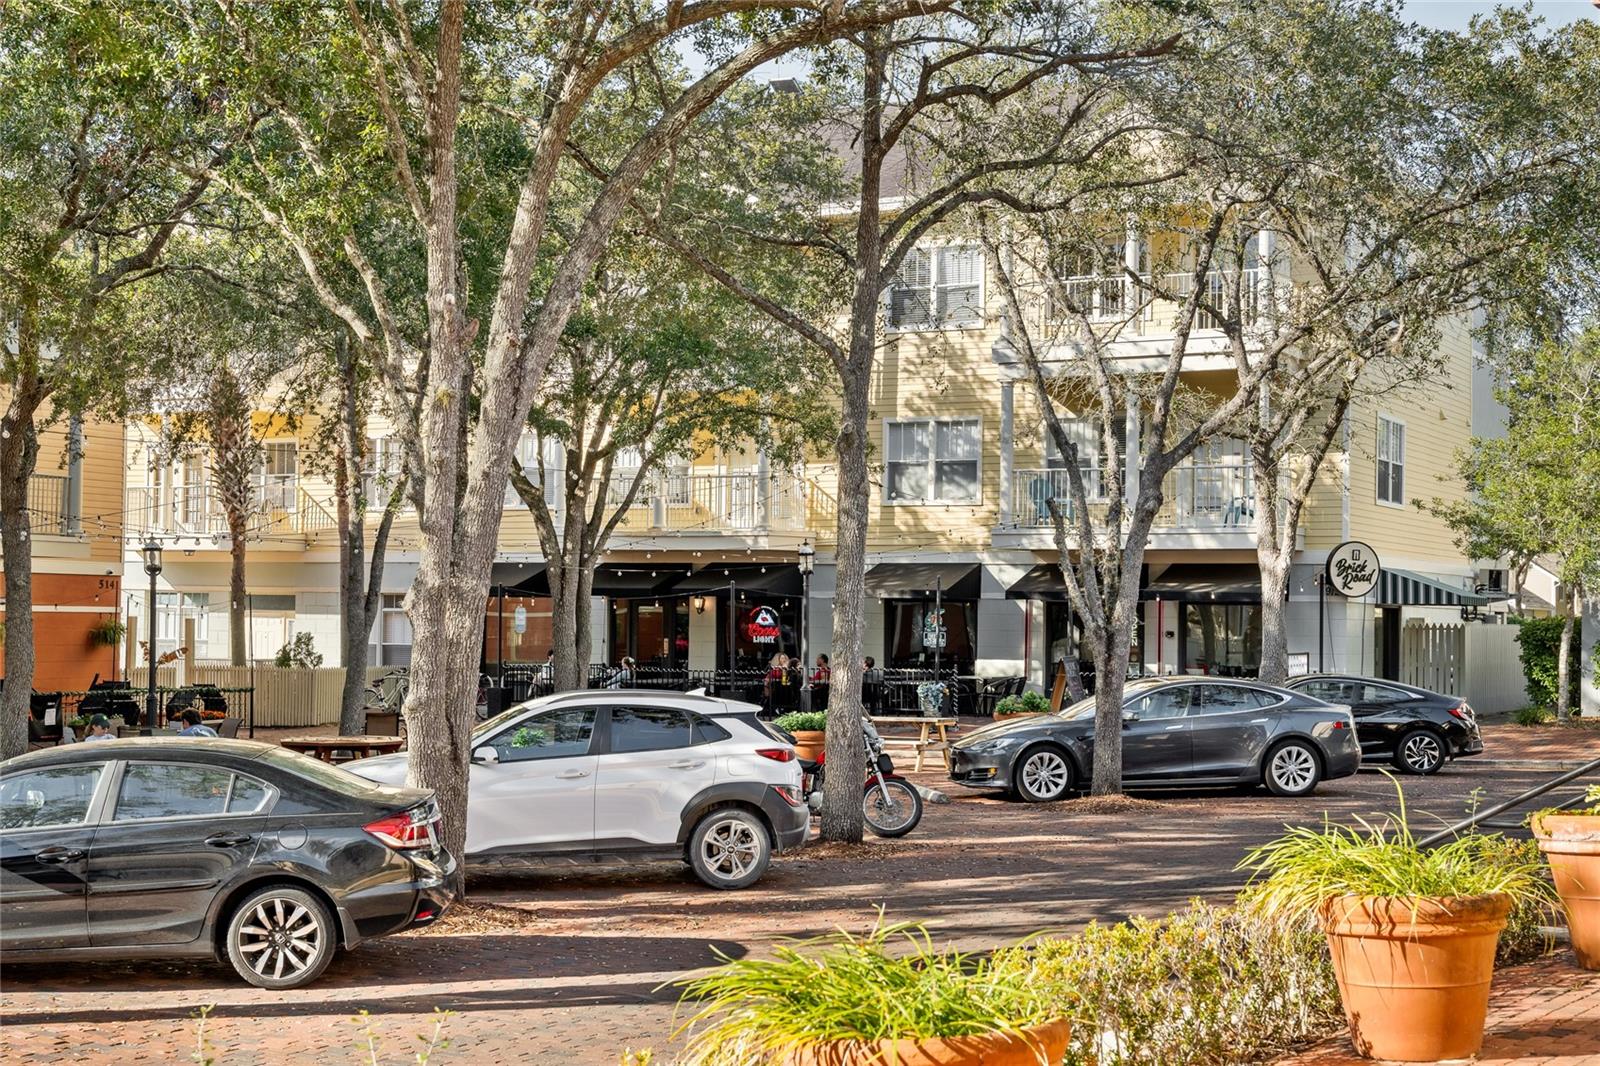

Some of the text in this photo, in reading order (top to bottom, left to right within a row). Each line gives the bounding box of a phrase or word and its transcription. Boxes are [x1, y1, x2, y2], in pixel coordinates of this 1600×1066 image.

[1335, 558, 1368, 577] Brick
[98, 579, 115, 590] 514
[1342, 568, 1377, 591] Road
[752, 635, 775, 644] LIGHT
